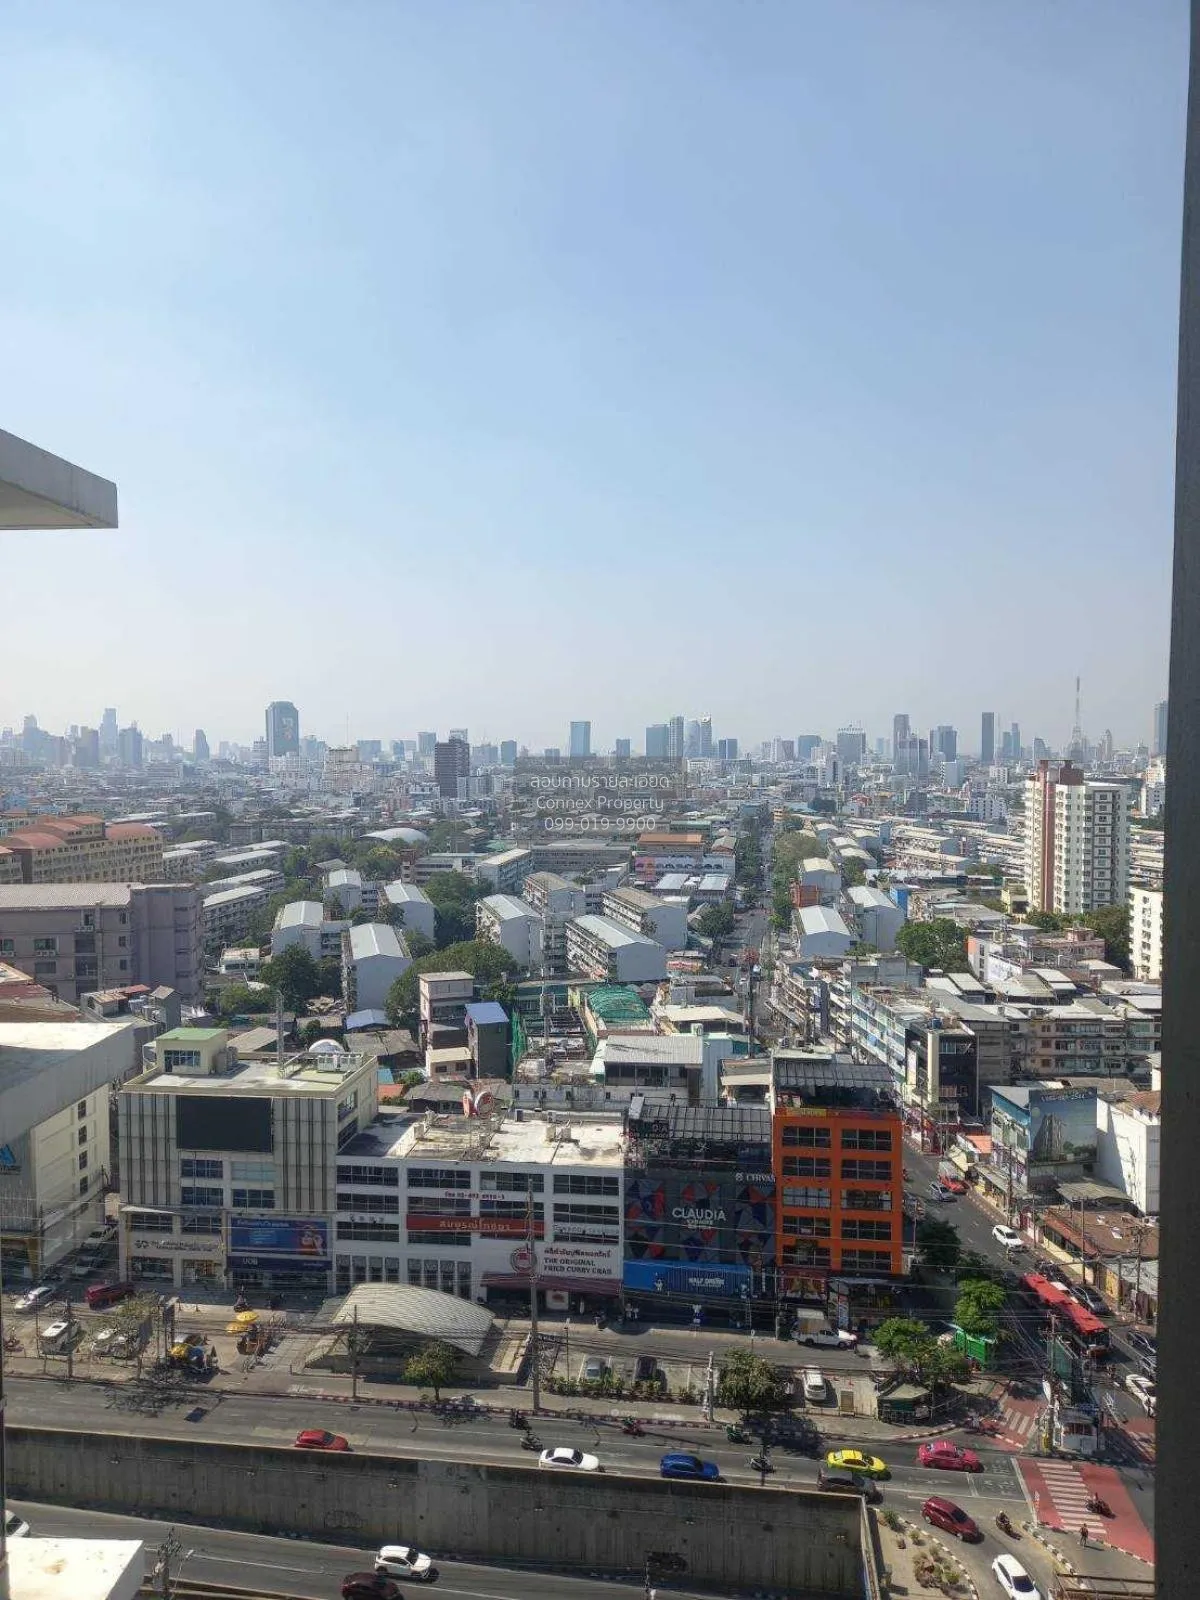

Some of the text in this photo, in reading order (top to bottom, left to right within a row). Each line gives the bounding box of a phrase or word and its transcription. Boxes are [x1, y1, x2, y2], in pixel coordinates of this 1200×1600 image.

[671, 1207, 727, 1221] CLAUDIA
[560, 1258, 596, 1267] ORIGINAL
[566, 1266, 591, 1274] CURRY
